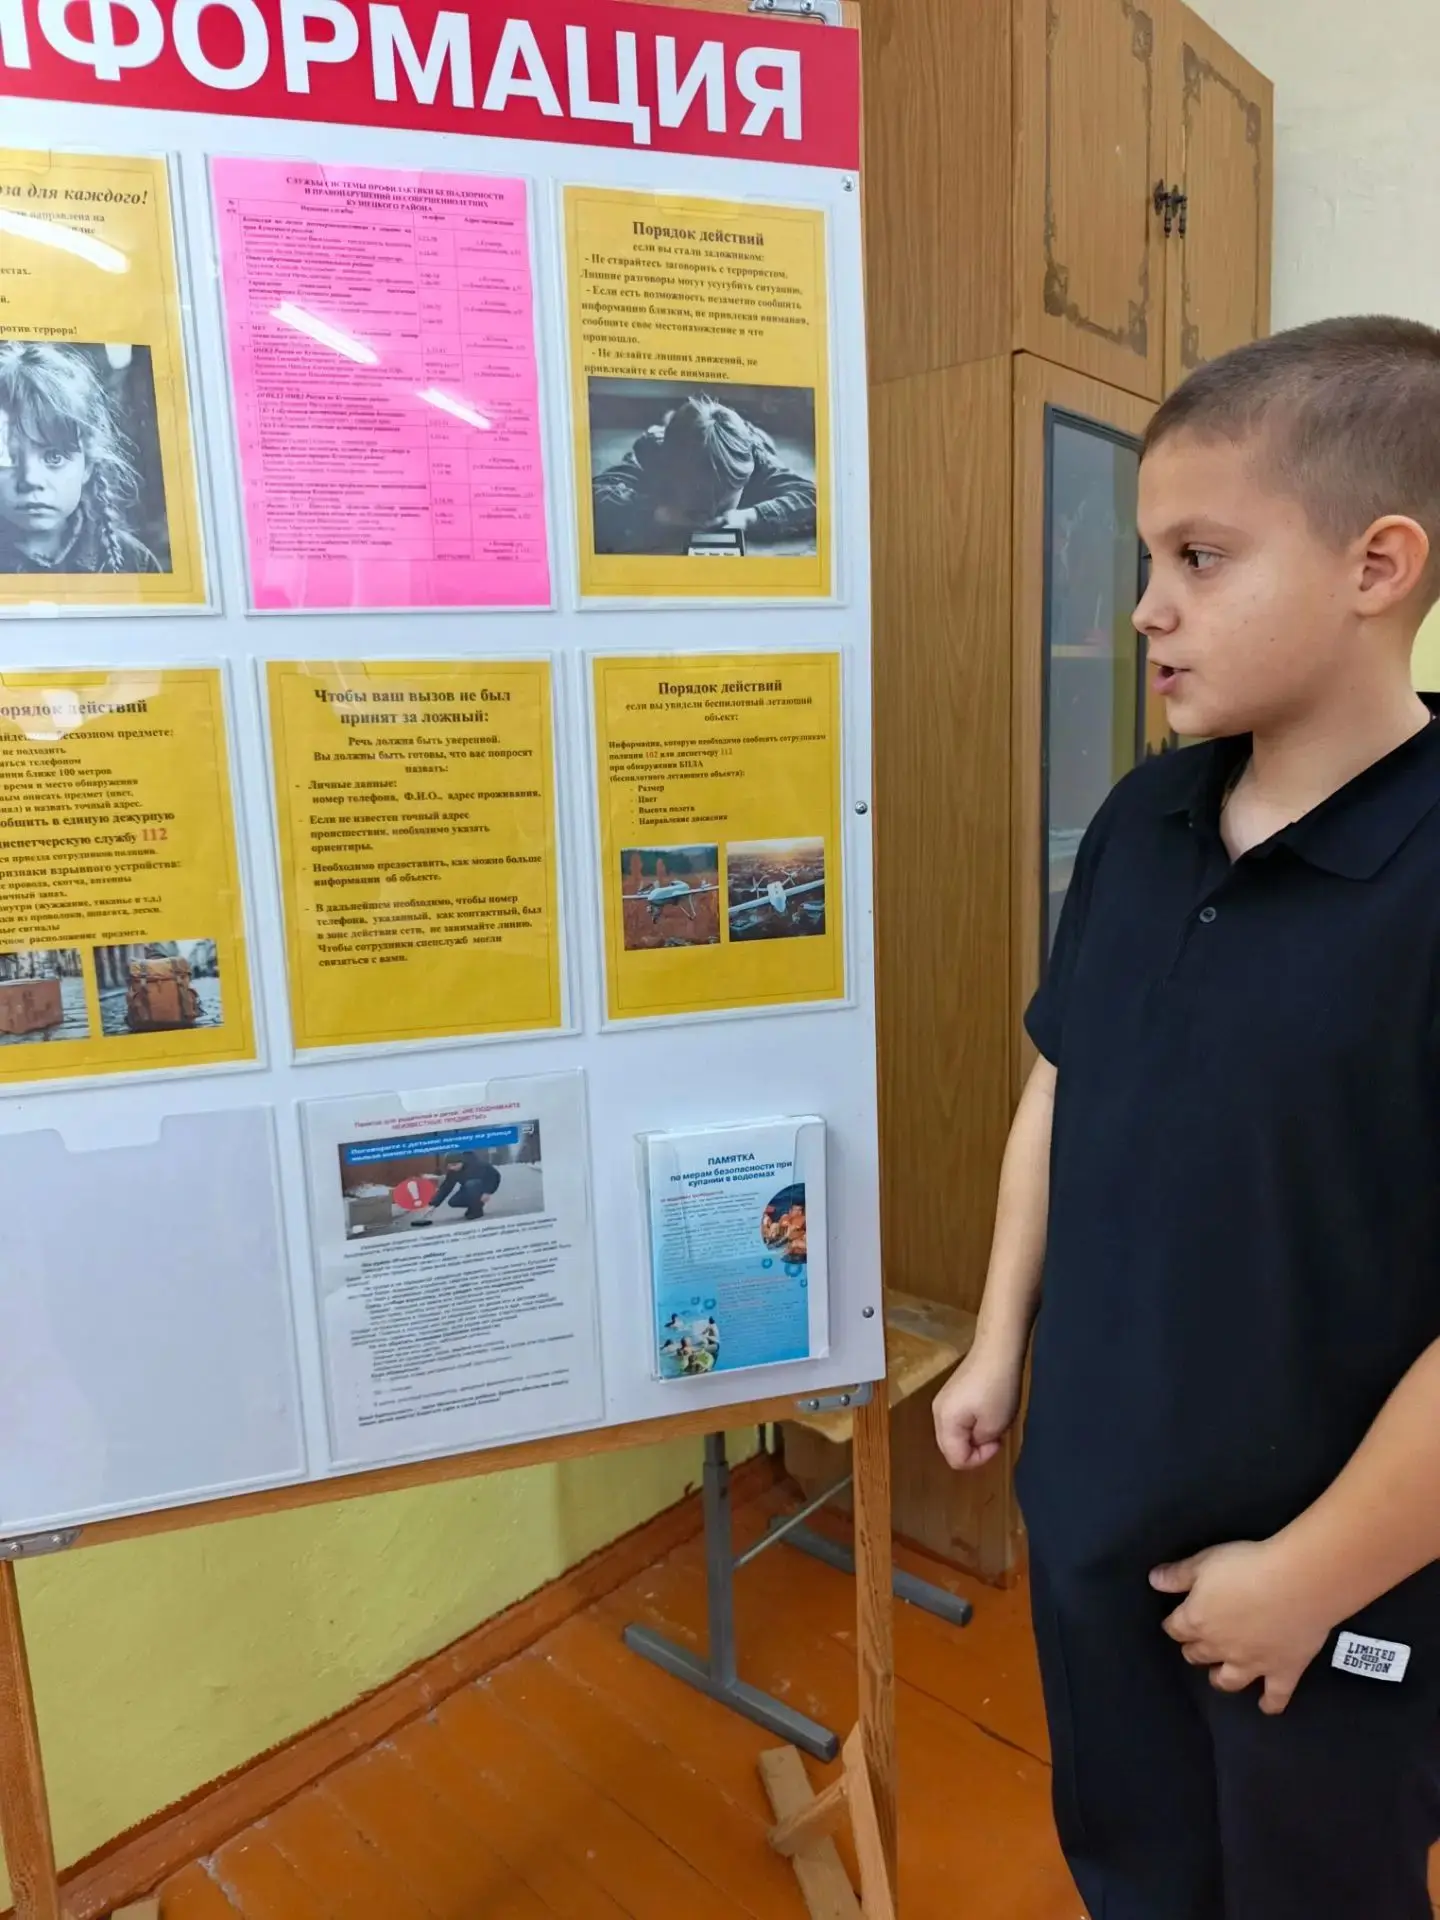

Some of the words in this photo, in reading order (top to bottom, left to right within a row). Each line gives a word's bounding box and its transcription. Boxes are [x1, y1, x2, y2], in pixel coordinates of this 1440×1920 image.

[28, 183, 58, 199] для
[65, 188, 148, 205] каждого!
[633, 221, 696, 240] Порядок
[700, 228, 764, 246] действий
[633, 244, 655, 252] если
[674, 248, 701, 256] стали
[705, 250, 764, 261] заложником:
[592, 254, 605, 263] Не
[608, 256, 662, 269] старайтесь
[665, 261, 717, 275] заговорить
[728, 267, 788, 279] террористом.
[581, 271, 621, 280] Лишние
[624, 275, 675, 287] разговоры
[678, 278, 704, 289] могут
[708, 281, 753, 293] усугубить
[592, 287, 617, 296] Если
[644, 291, 704, 302] возможность
[708, 295, 755, 305] незаметно
[758, 299, 802, 310] сообщить
[582, 302, 646, 316] информацию
[649, 305, 693, 318] близким,
[34, 326, 77, 335] террора!
[582, 318, 629, 328] сообщите
[655, 323, 737, 336] местонахождение
[583, 334, 640, 344] произошло.
[598, 348, 612, 358] Не
[615, 350, 652, 360] делайте
[655, 353, 693, 363] лишних
[696, 356, 744, 366] движений,
[585, 364, 646, 377] привлекайте
[659, 368, 678, 377] себе
[681, 370, 729, 380] внимание.
[315, 689, 367, 703] Чтобы
[373, 691, 404, 701] ваш
[410, 690, 455, 701] вызов
[460, 691, 477, 701] не
[481, 689, 510, 701] был
[658, 682, 717, 697] Порядок
[721, 680, 782, 694] действий
[650, 702, 663, 710] вы
[665, 701, 702, 712] увидели
[705, 697, 764, 709] беспилотный
[766, 697, 812, 707] летающий
[341, 713, 399, 726] принят
[403, 712, 417, 724] за
[422, 709, 488, 723] ложный:
[705, 713, 739, 722] объект:
[57, 730, 114, 740] есхозном
[118, 729, 174, 740] предмете:
[348, 737, 373, 746] Речь
[376, 737, 414, 747] должна
[417, 736, 442, 745] быть
[446, 735, 500, 747] уверенной.
[314, 752, 330, 761] Вы
[334, 752, 376, 761] должны
[379, 751, 405, 759] быть
[408, 750, 447, 760] готовы,
[488, 749, 533, 760] попросят
[646, 751, 658, 759] 102
[26, 770, 56, 778] ближе
[59, 768, 75, 776] 100
[78, 768, 112, 777] метров
[405, 765, 448, 773] назвать:
[4, 783, 33, 792] время
[308, 780, 351, 789] Личные
[355, 779, 397, 789] данные:
[638, 784, 664, 794] Размер
[313, 794, 344, 805] номер
[348, 793, 399, 804] телефона,
[448, 791, 475, 802] адрес
[478, 789, 541, 800] проживания.
[638, 795, 657, 804] Цвет
[0, 817, 48, 827] общить
[53, 817, 60, 825] в
[63, 815, 109, 826] единую
[113, 812, 175, 825] дежурную
[94, 832, 136, 844] службу
[142, 828, 167, 842] 112
[51, 865, 112, 877] взрывного
[114, 861, 180, 873] устройства:
[313, 862, 374, 873] Необходимо
[377, 860, 449, 871] предоставить,
[452, 857, 468, 866] как
[472, 856, 503, 865] можно
[506, 854, 542, 864] больше
[708, 1153, 755, 1165] ПАМЯТКА
[670, 1174, 681, 1182] по
[683, 1170, 713, 1181] мерам
[714, 1163, 775, 1177] безопасности
[777, 1160, 792, 1171] при
[688, 1175, 724, 1188] купании
[732, 1170, 775, 1181] водоемах
[1347, 1642, 1396, 1661] LIMITED
[1343, 1655, 1392, 1673] EDITION
